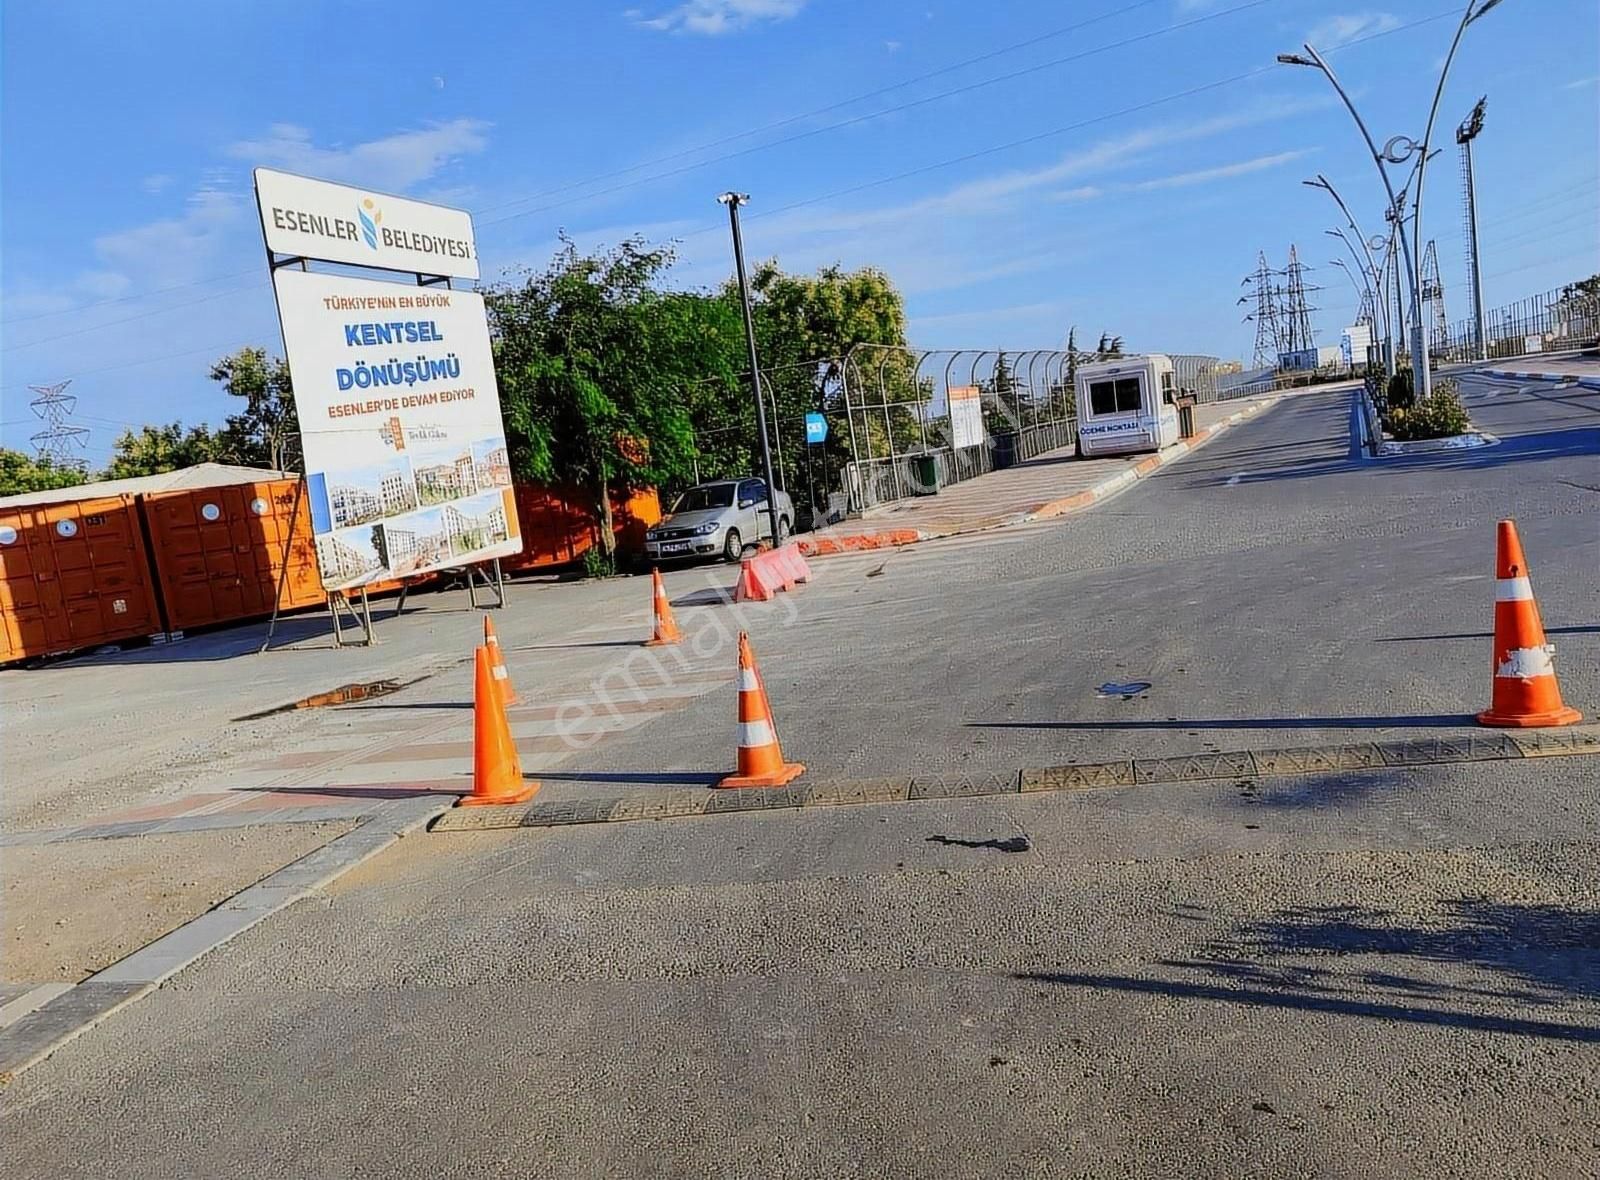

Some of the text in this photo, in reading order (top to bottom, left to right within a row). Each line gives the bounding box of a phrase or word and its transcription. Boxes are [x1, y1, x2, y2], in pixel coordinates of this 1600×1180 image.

[272, 207, 359, 242] ESENLER
[399, 297, 414, 308] EN
[416, 293, 451, 308] BÜYÜK
[344, 320, 444, 347] KENTSEL
[336, 353, 460, 391] DÖNÜŞÜMÜ
[328, 398, 399, 418] ESENLER'DE
[401, 392, 438, 409] DEVAM
